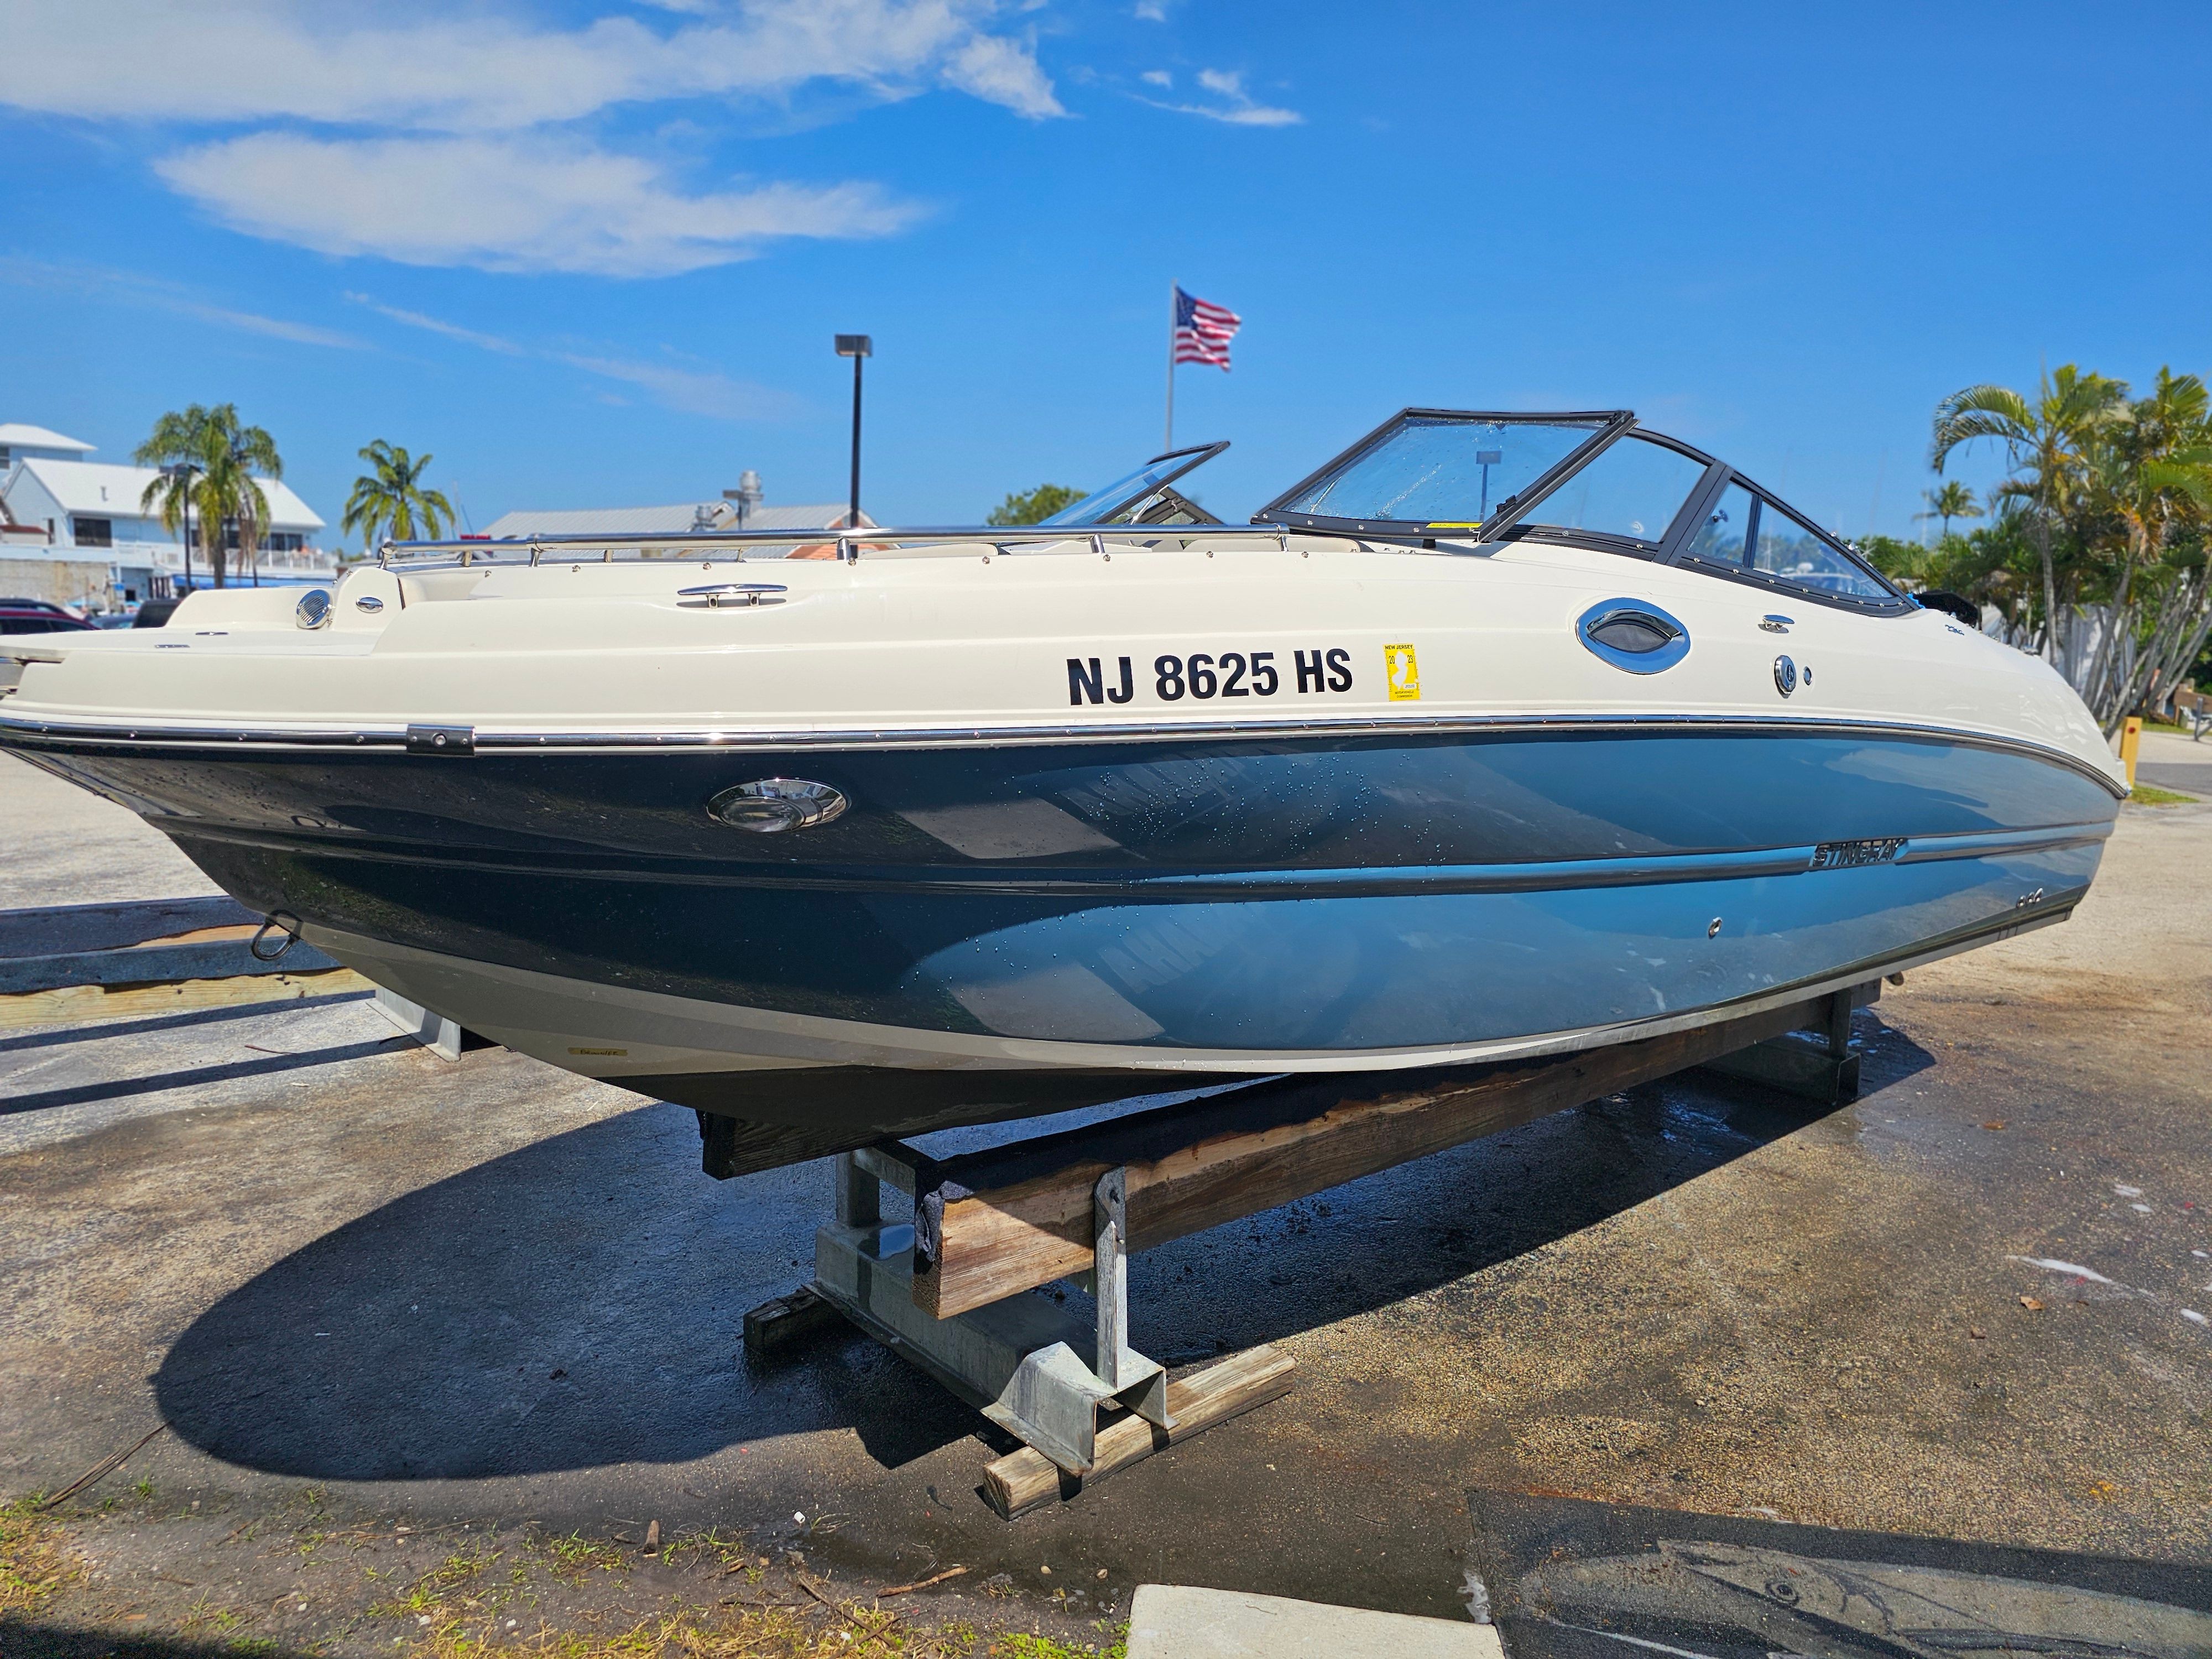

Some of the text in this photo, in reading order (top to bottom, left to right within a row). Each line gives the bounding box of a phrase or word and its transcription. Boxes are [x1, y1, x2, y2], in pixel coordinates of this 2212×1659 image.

[1389, 654, 1413, 664] 20 23
[1066, 656, 1133, 705] NJ
[1154, 652, 1279, 701] 8625
[1293, 648, 1353, 693] HS
[1813, 837, 1908, 867] STINGRAY
